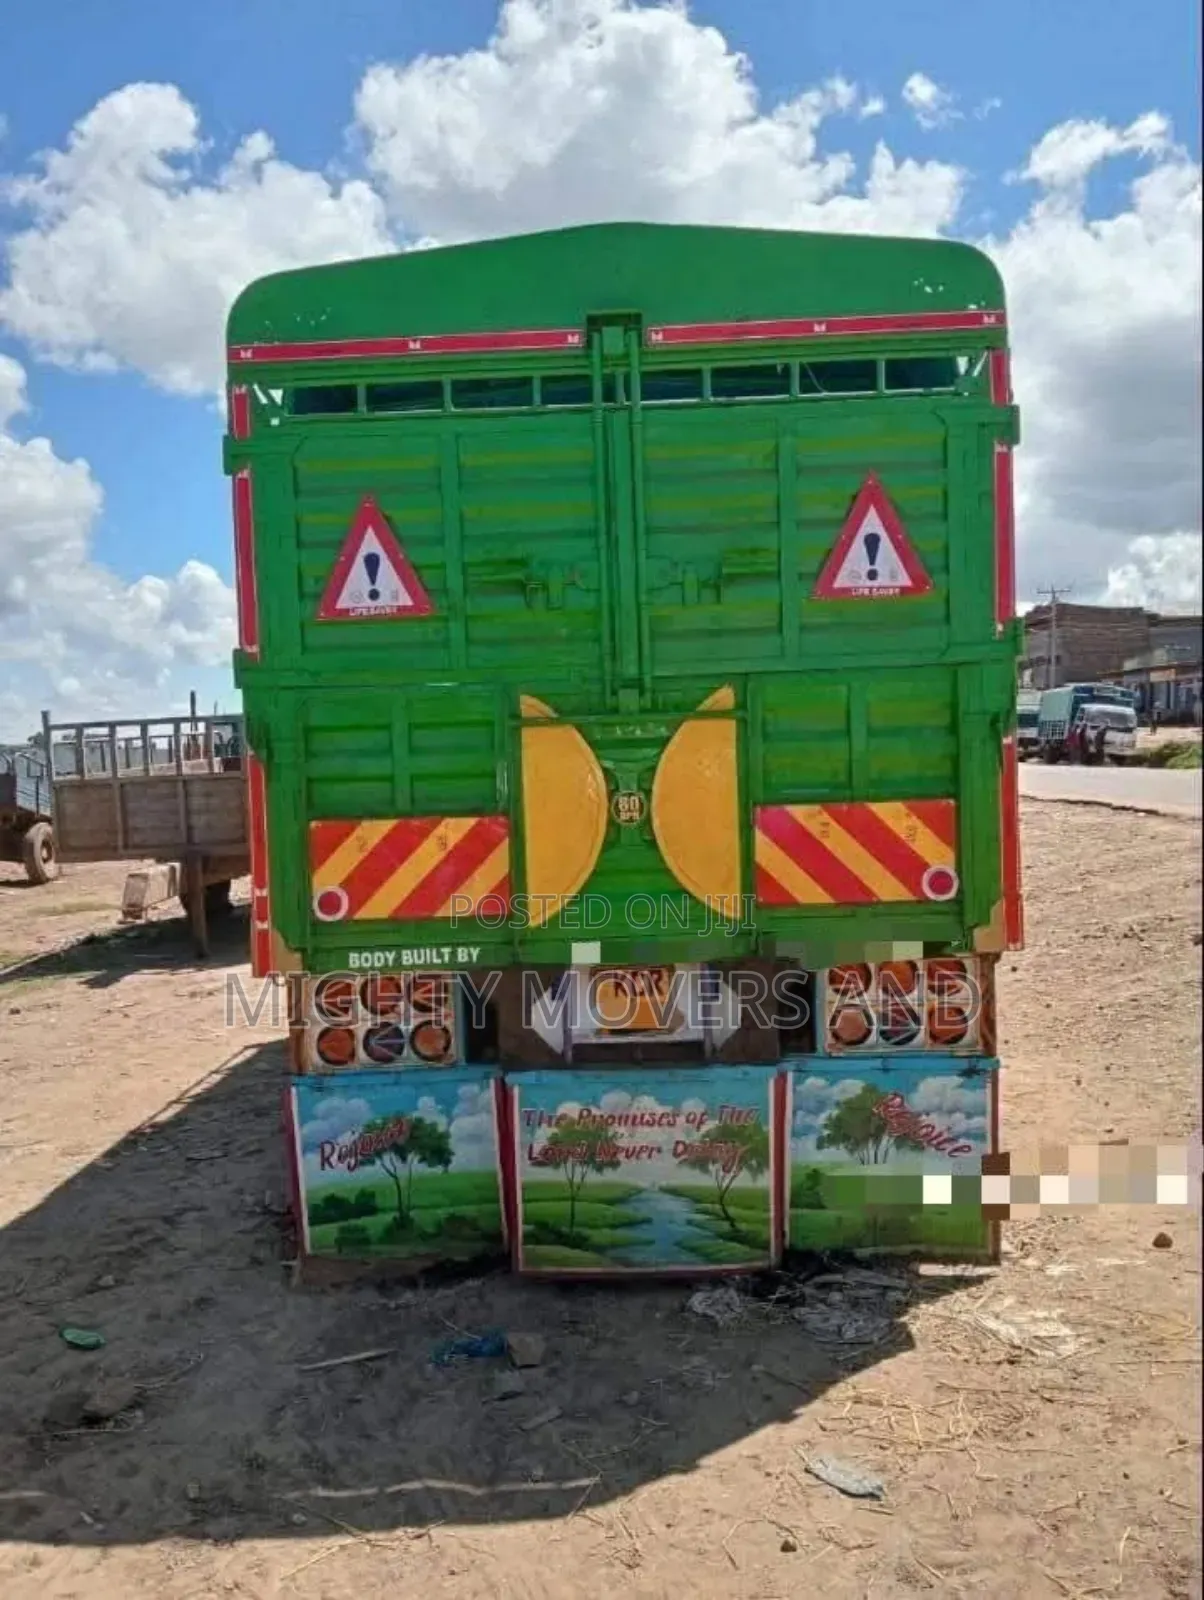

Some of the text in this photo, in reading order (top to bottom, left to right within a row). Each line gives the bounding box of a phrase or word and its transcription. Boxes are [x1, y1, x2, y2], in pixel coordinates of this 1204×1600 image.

[348, 947, 481, 969] BODY BUILT BY
[523, 1107, 569, 1128] The
[577, 1107, 681, 1129] Promises
[685, 1109, 709, 1132] of
